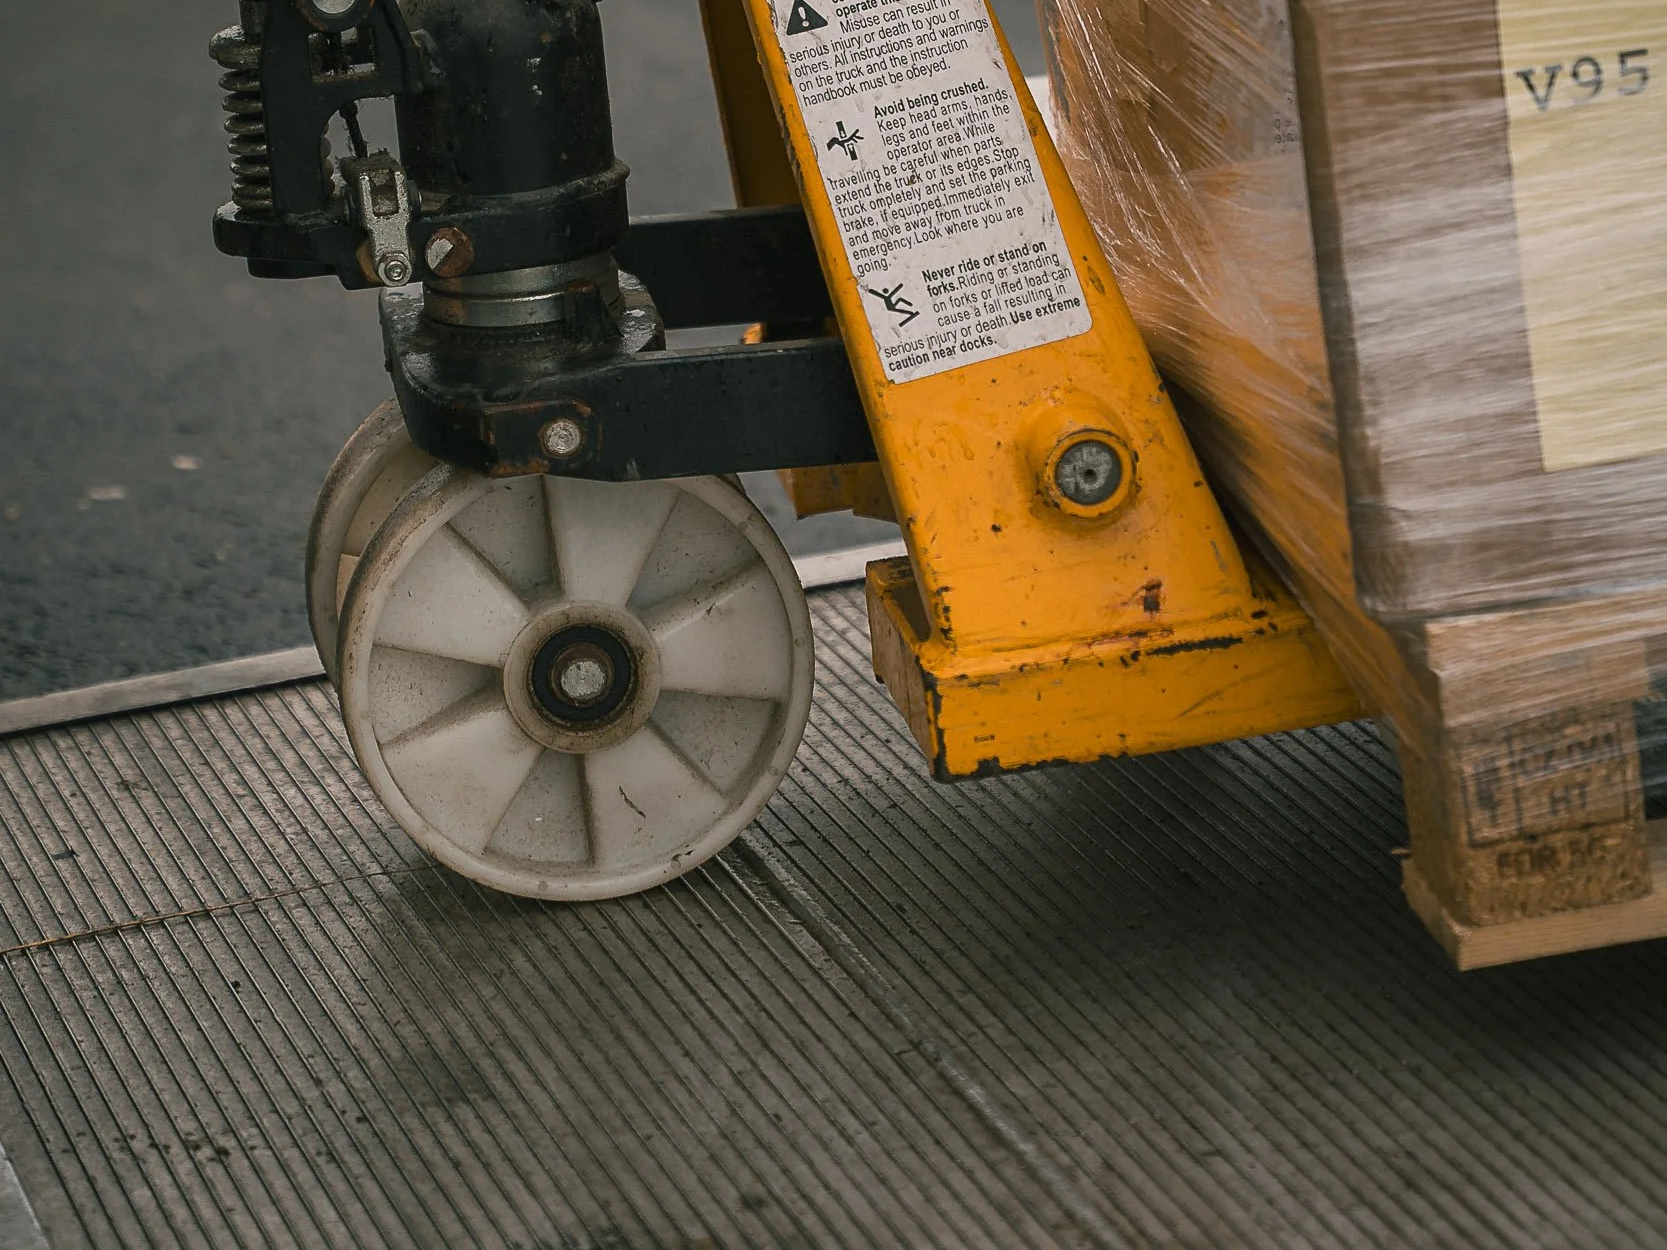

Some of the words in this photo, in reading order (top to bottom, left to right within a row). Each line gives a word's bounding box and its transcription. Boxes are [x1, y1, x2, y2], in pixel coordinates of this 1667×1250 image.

[789, 44, 830, 64] serious
[830, 35, 861, 54] injury
[863, 31, 875, 44] or
[878, 21, 911, 40] death
[911, 18, 924, 31] to
[924, 13, 947, 31] you
[948, 9, 960, 21] or
[839, 14, 881, 34] Misuse
[882, 8, 905, 23] can
[834, 52, 849, 68] All
[849, 37, 914, 63] instructions
[915, 28, 938, 46] and
[938, 18, 989, 39] warnings
[798, 80, 814, 93] on
[815, 74, 834, 88] the
[835, 65, 865, 83] truck
[865, 58, 888, 75] and
[889, 55, 909, 69] the
[910, 38, 969, 63] instruction
[1516, 49, 1650, 110] V95
[802, 82, 859, 107] handbook
[859, 73, 888, 92] must
[887, 71, 904, 84] be
[874, 98, 906, 119] Avoid
[905, 93, 940, 110] being
[876, 116, 907, 133] Keep
[908, 105, 938, 125] head
[881, 132, 906, 147] legs
[908, 122, 930, 140] and
[931, 117, 955, 133] feet
[955, 109, 990, 127] within
[991, 103, 1010, 117] the
[881, 164, 898, 177] be
[900, 150, 939, 172] careful
[940, 144, 972, 161] when
[973, 135, 1003, 155] parts
[886, 139, 936, 162] operator
[834, 183, 872, 205] extend
[873, 179, 893, 195] the
[894, 170, 924, 189] truck
[925, 168, 937, 181] or
[939, 163, 955, 177] its
[837, 200, 868, 219] truck
[869, 186, 922, 213] ompletely
[925, 178, 947, 196] and
[948, 173, 968, 189] set
[968, 168, 987, 184] the
[989, 158, 1032, 181] parking
[879, 208, 889, 223] if
[1014, 169, 1036, 187] exit
[848, 230, 870, 247] and
[871, 224, 902, 241] move
[904, 215, 936, 235] away
[935, 208, 962, 224] from
[963, 197, 993, 216] truck
[993, 195, 1006, 208] in
[944, 218, 979, 236] where
[981, 212, 1003, 230] you
[1005, 206, 1024, 220] are
[921, 265, 955, 283] Never
[957, 257, 981, 274] ride
[982, 254, 995, 267] or
[997, 242, 1030, 263] stand
[1031, 241, 1048, 254] on
[997, 267, 1009, 279] or
[1011, 253, 1061, 275] standing
[932, 301, 948, 314] on
[949, 292, 978, 309] forks
[980, 288, 992, 301] or
[1024, 270, 1050, 288] load
[1050, 267, 1072, 281] can
[937, 310, 971, 327] cause
[973, 307, 982, 318] a
[983, 298, 1002, 315] fall
[1004, 287, 1056, 309] resulting
[1055, 284, 1067, 296] in
[884, 339, 925, 359] serious
[926, 329, 957, 350] injury
[960, 325, 972, 338] or
[1035, 297, 1081, 318] extreme
[888, 352, 931, 372] caution
[931, 345, 957, 361] near
